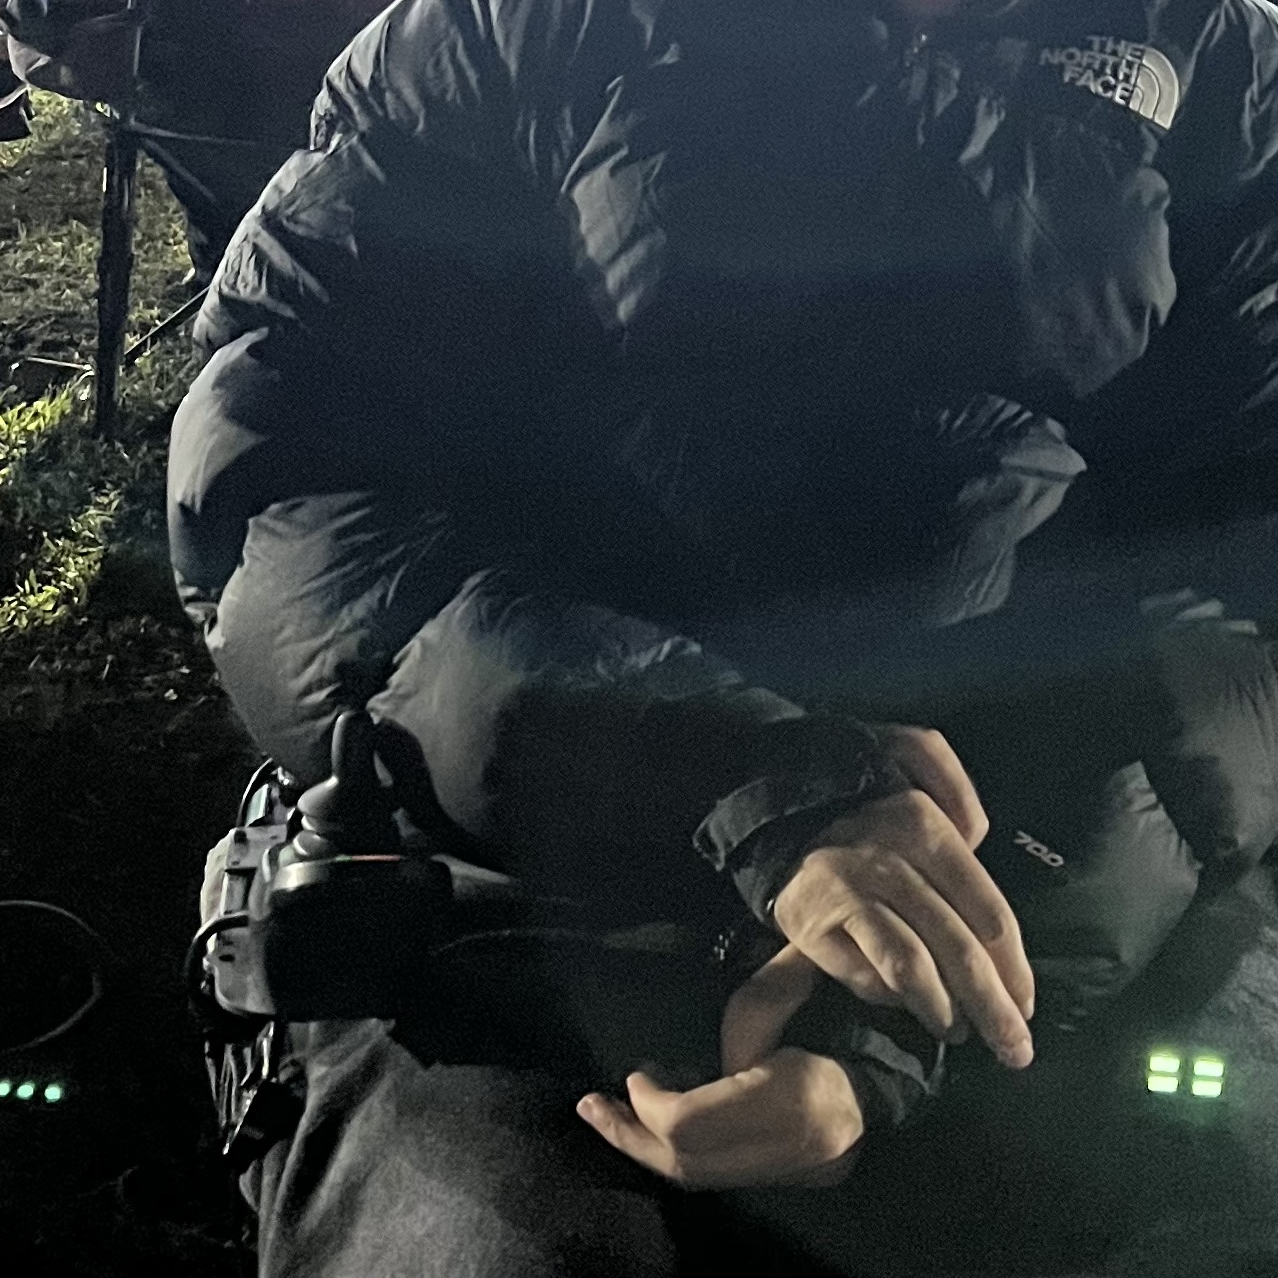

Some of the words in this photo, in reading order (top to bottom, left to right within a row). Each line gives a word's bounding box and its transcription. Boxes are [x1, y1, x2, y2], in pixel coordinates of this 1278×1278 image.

[1039, 46, 1139, 85] NORTH
[1086, 35, 1146, 63] THE
[1063, 64, 1134, 106] FACE
[1013, 829, 1064, 868] 700
